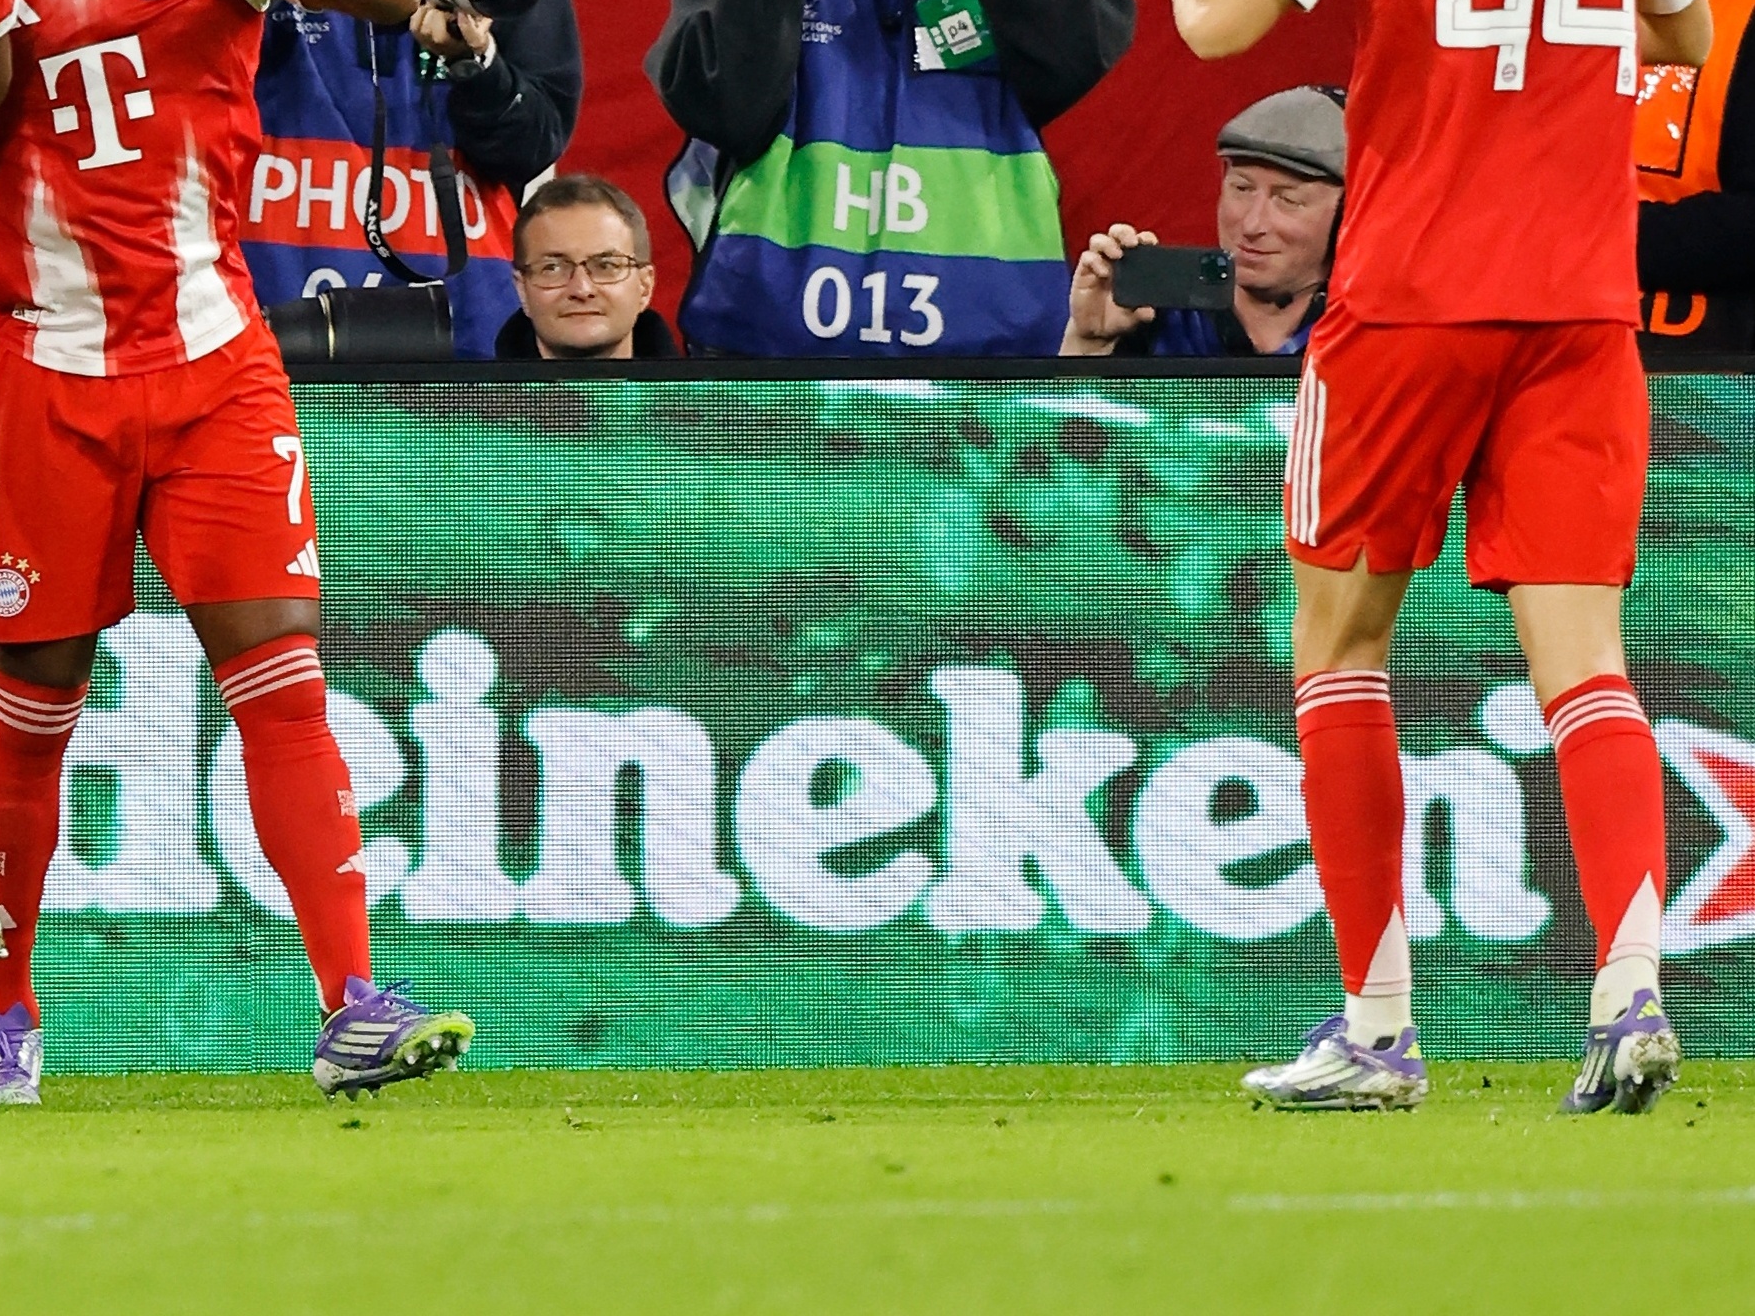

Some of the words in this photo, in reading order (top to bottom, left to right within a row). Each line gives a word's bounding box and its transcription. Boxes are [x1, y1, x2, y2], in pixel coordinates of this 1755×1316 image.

[38, 34, 155, 172] T
[249, 154, 487, 240] PHOTO
[365, 199, 391, 259] SONY
[833, 162, 929, 236] HB
[802, 266, 944, 347] 013
[272, 436, 305, 524] 7
